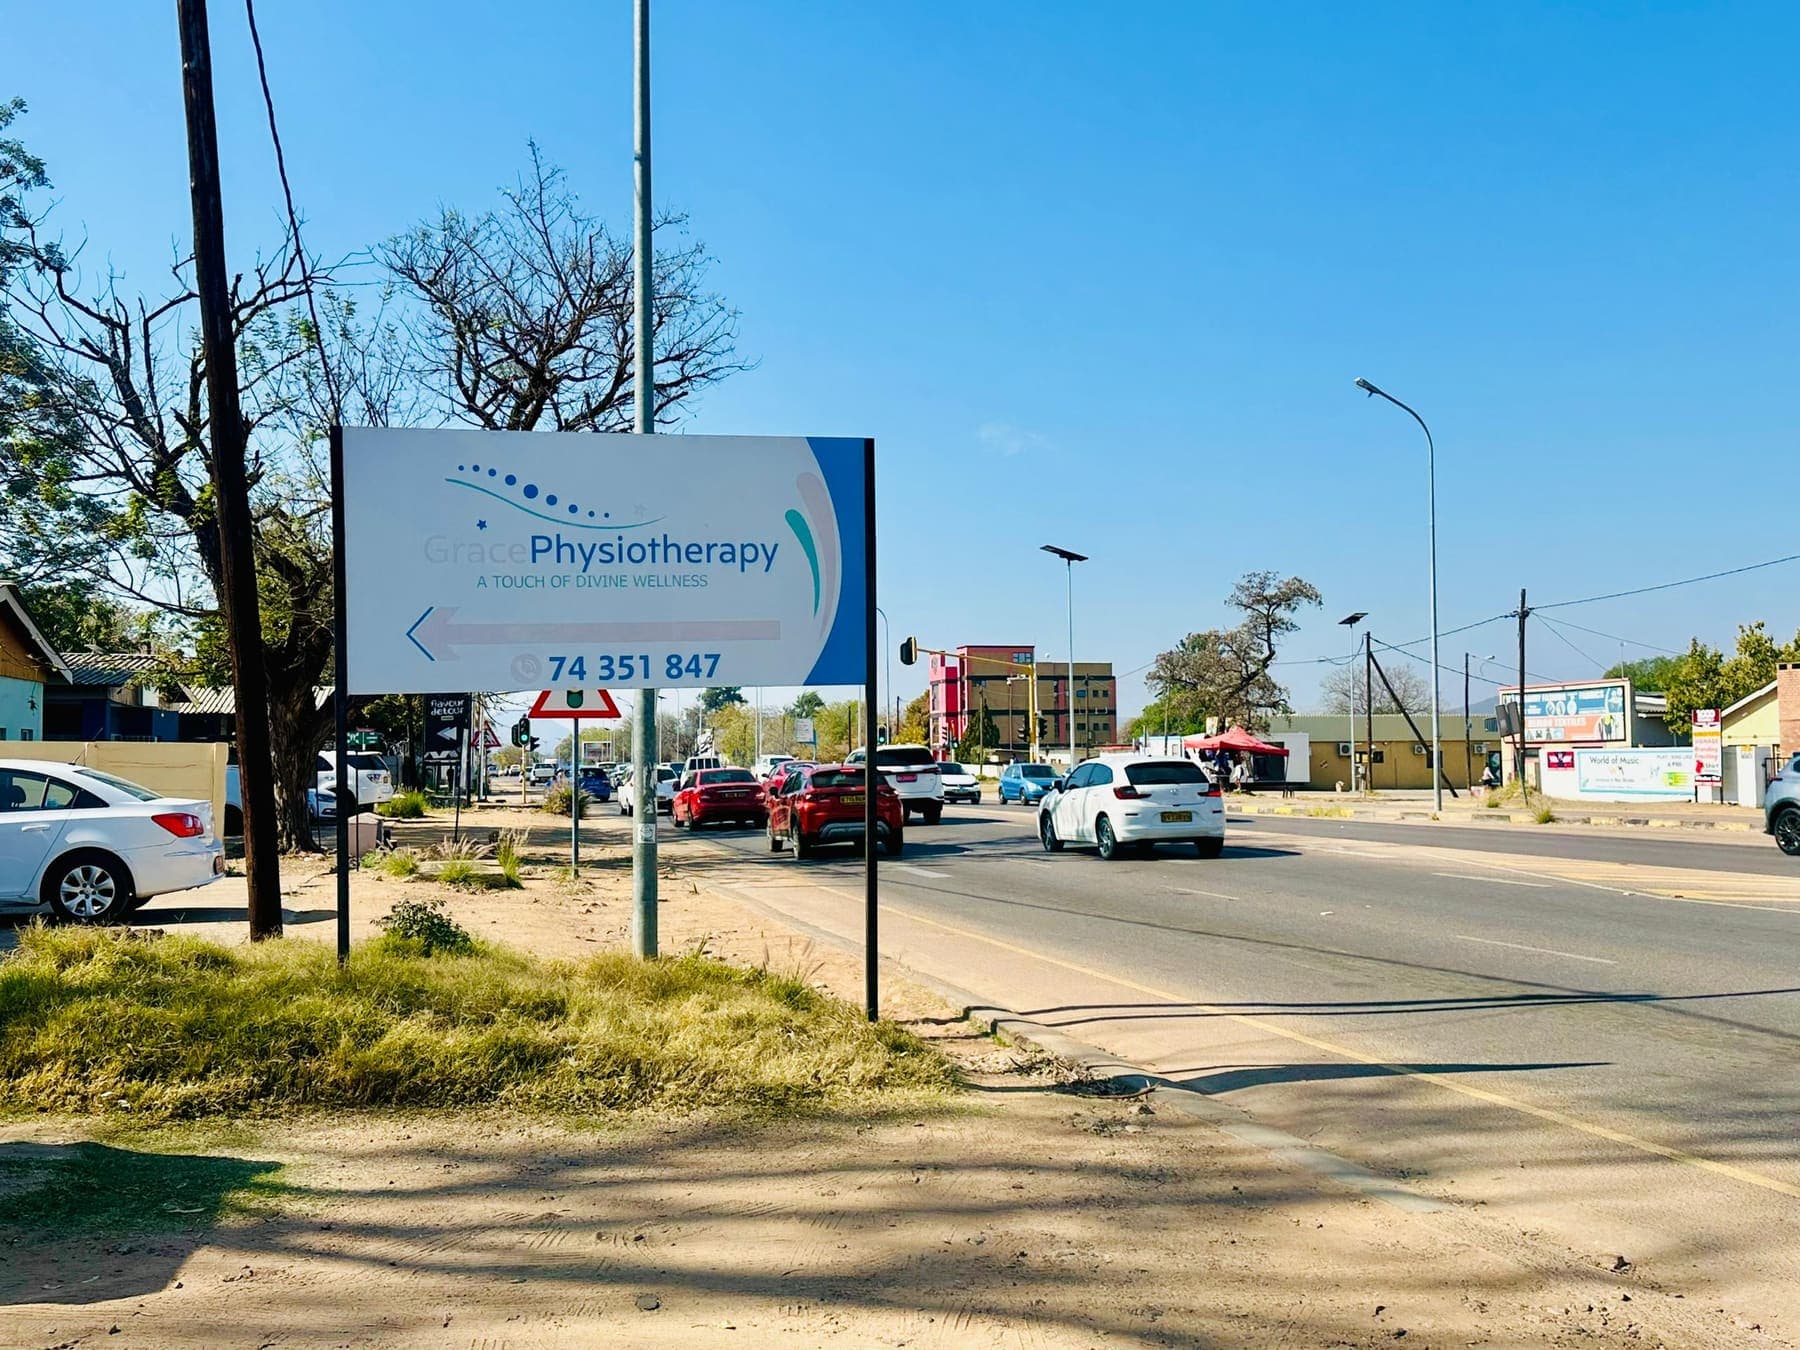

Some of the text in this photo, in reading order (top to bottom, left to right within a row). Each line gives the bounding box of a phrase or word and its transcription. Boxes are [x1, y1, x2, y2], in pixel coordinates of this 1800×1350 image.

[476, 574, 708, 588] A TOUCH OF DIVINE WELLNESS
[548, 653, 721, 682] 74 351 847
[1589, 755, 1640, 765] World of Music
